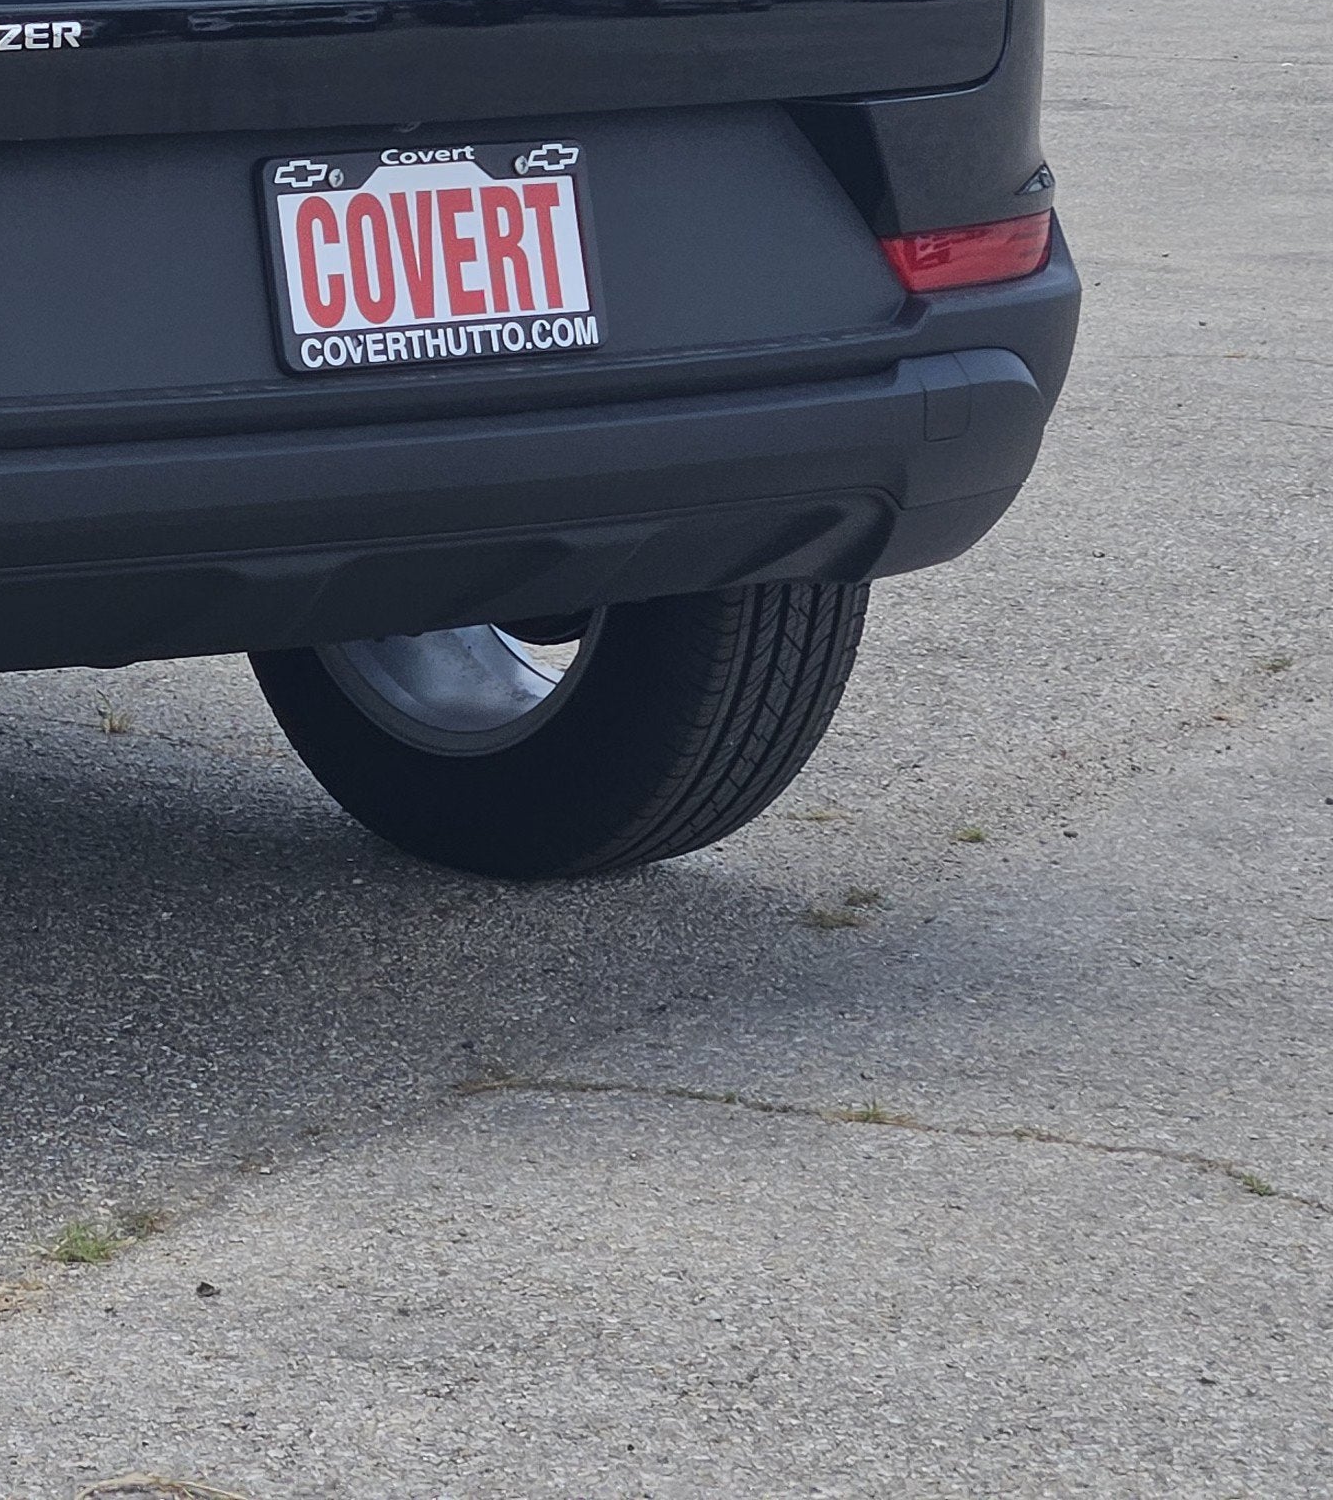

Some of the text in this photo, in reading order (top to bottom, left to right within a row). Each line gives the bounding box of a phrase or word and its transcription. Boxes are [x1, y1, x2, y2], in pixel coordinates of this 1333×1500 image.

[380, 145, 476, 166] Covert
[295, 182, 561, 329] COVERT
[300, 316, 600, 369] COVERTHUTTO.COM
